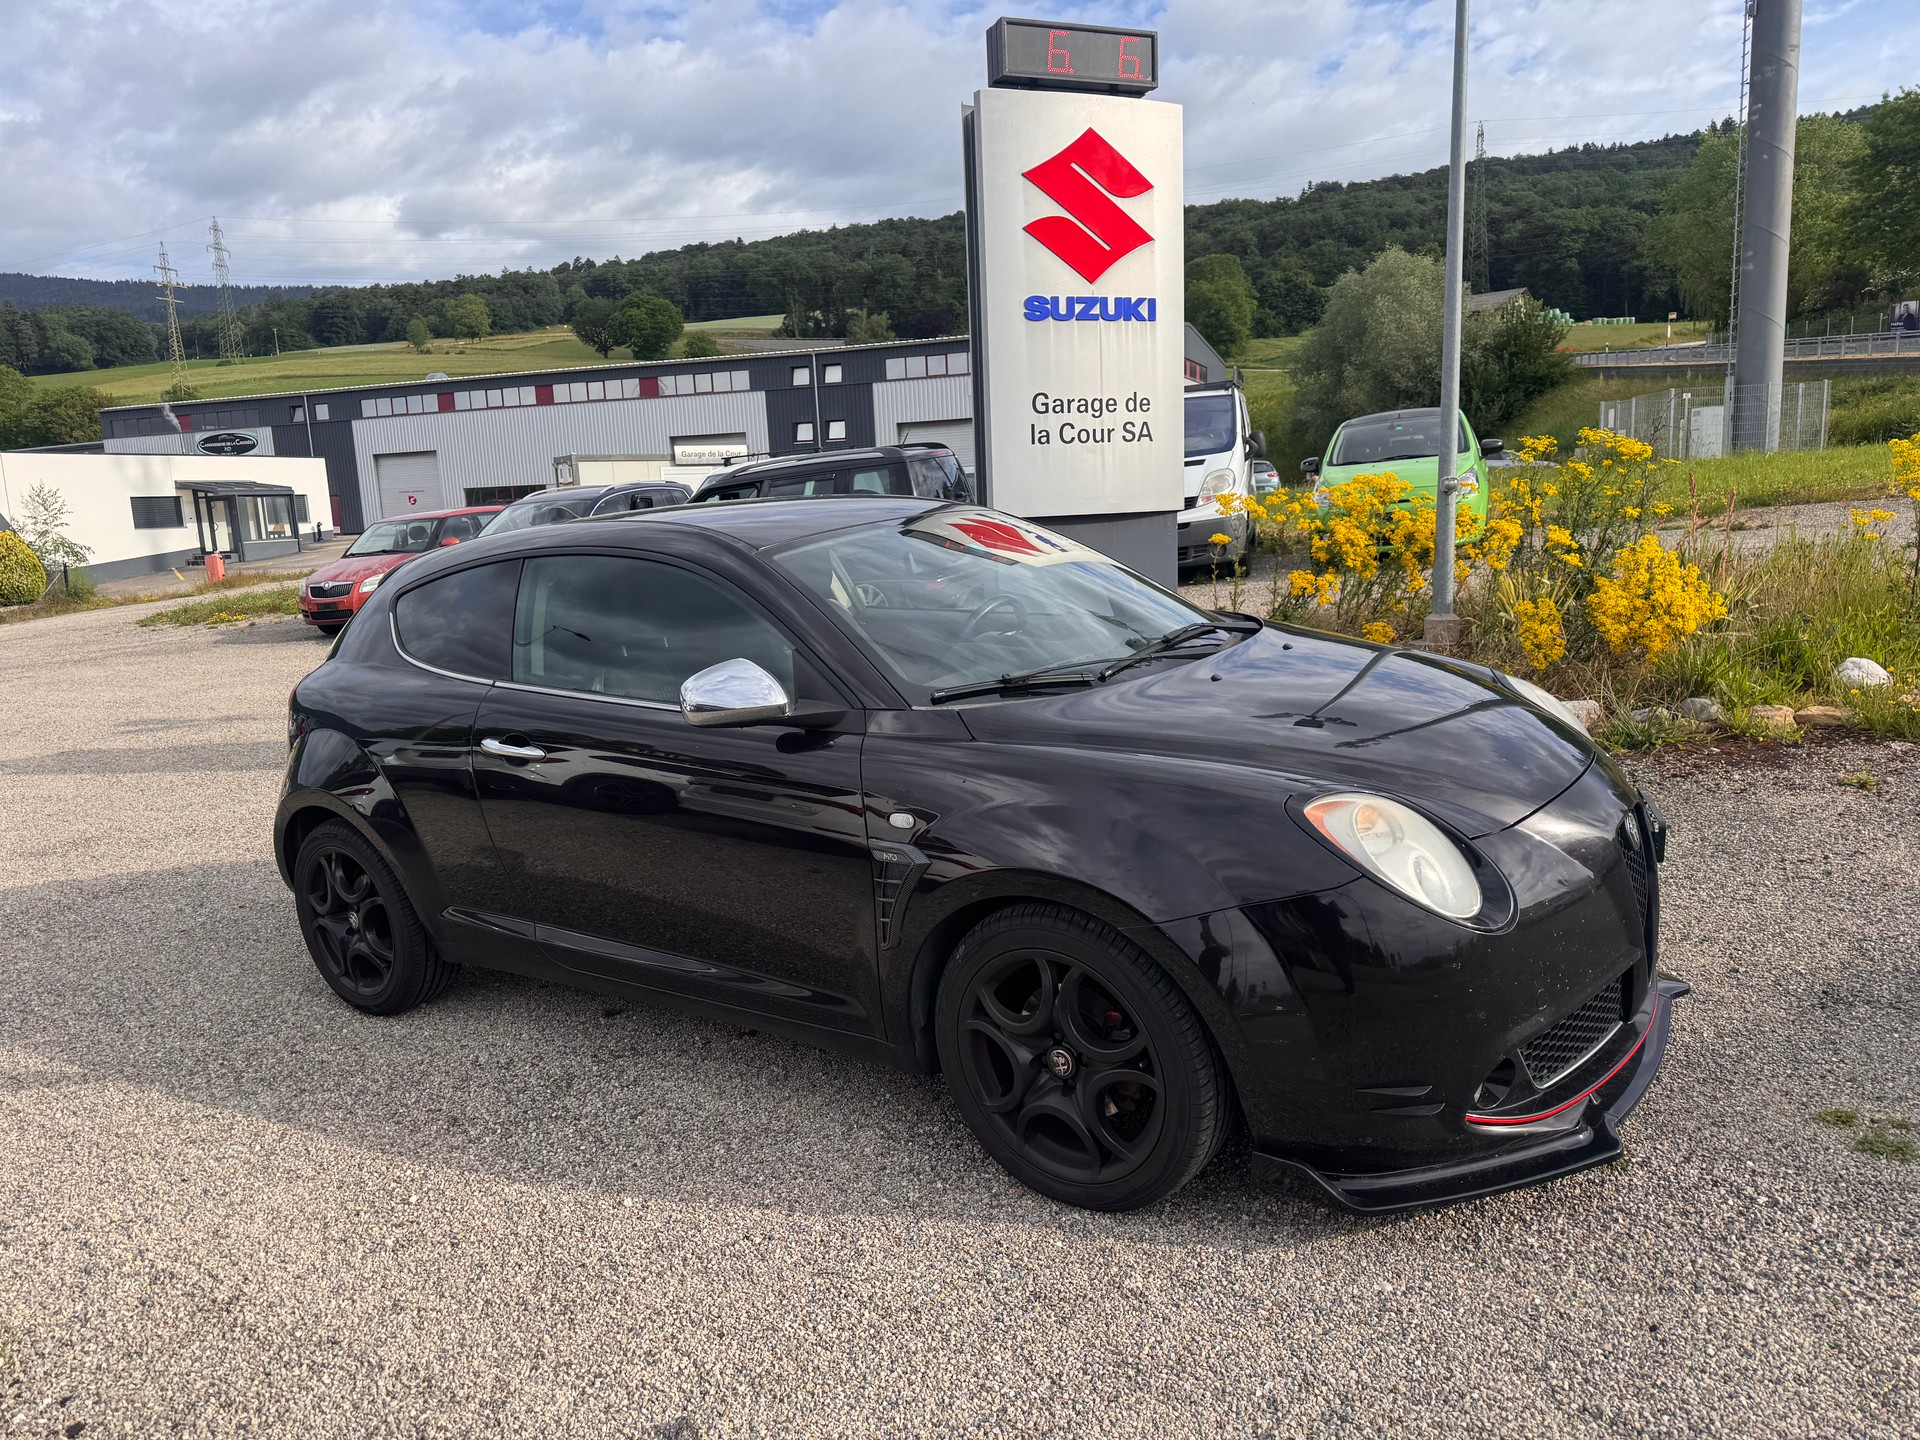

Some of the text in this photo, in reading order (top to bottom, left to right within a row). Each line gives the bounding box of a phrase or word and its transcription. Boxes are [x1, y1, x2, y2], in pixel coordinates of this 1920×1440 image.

[1023, 295, 1157, 321] SUZUKI
[1031, 391, 1151, 418] Garage de
[1030, 421, 1153, 445] la Cour SA
